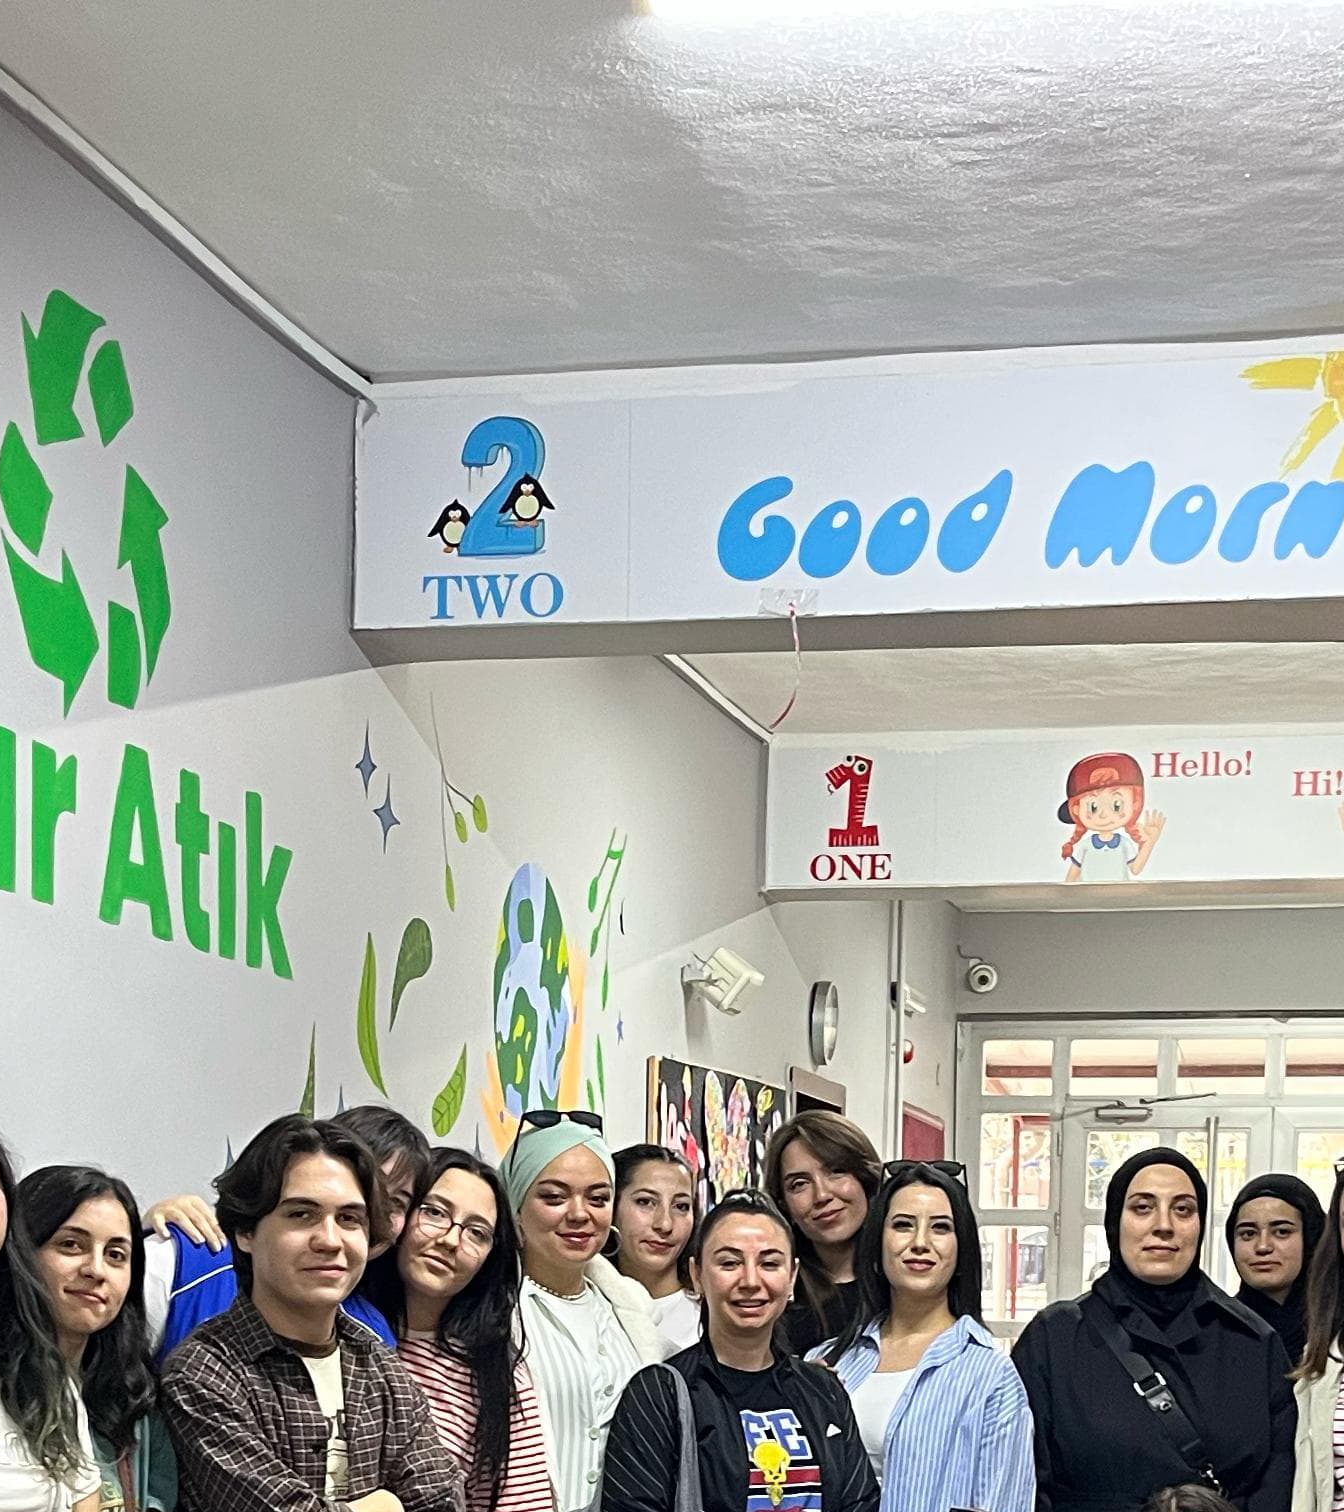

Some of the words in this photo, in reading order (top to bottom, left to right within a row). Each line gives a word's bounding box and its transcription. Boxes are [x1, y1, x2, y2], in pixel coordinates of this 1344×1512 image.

[717, 469, 1013, 581] Good
[422, 572, 564, 619] TWO
[1151, 750, 1253, 778] Hello!
[1292, 770, 1344, 797] Hi!
[99, 744, 294, 980] Atık
[809, 853, 892, 882] ONE
